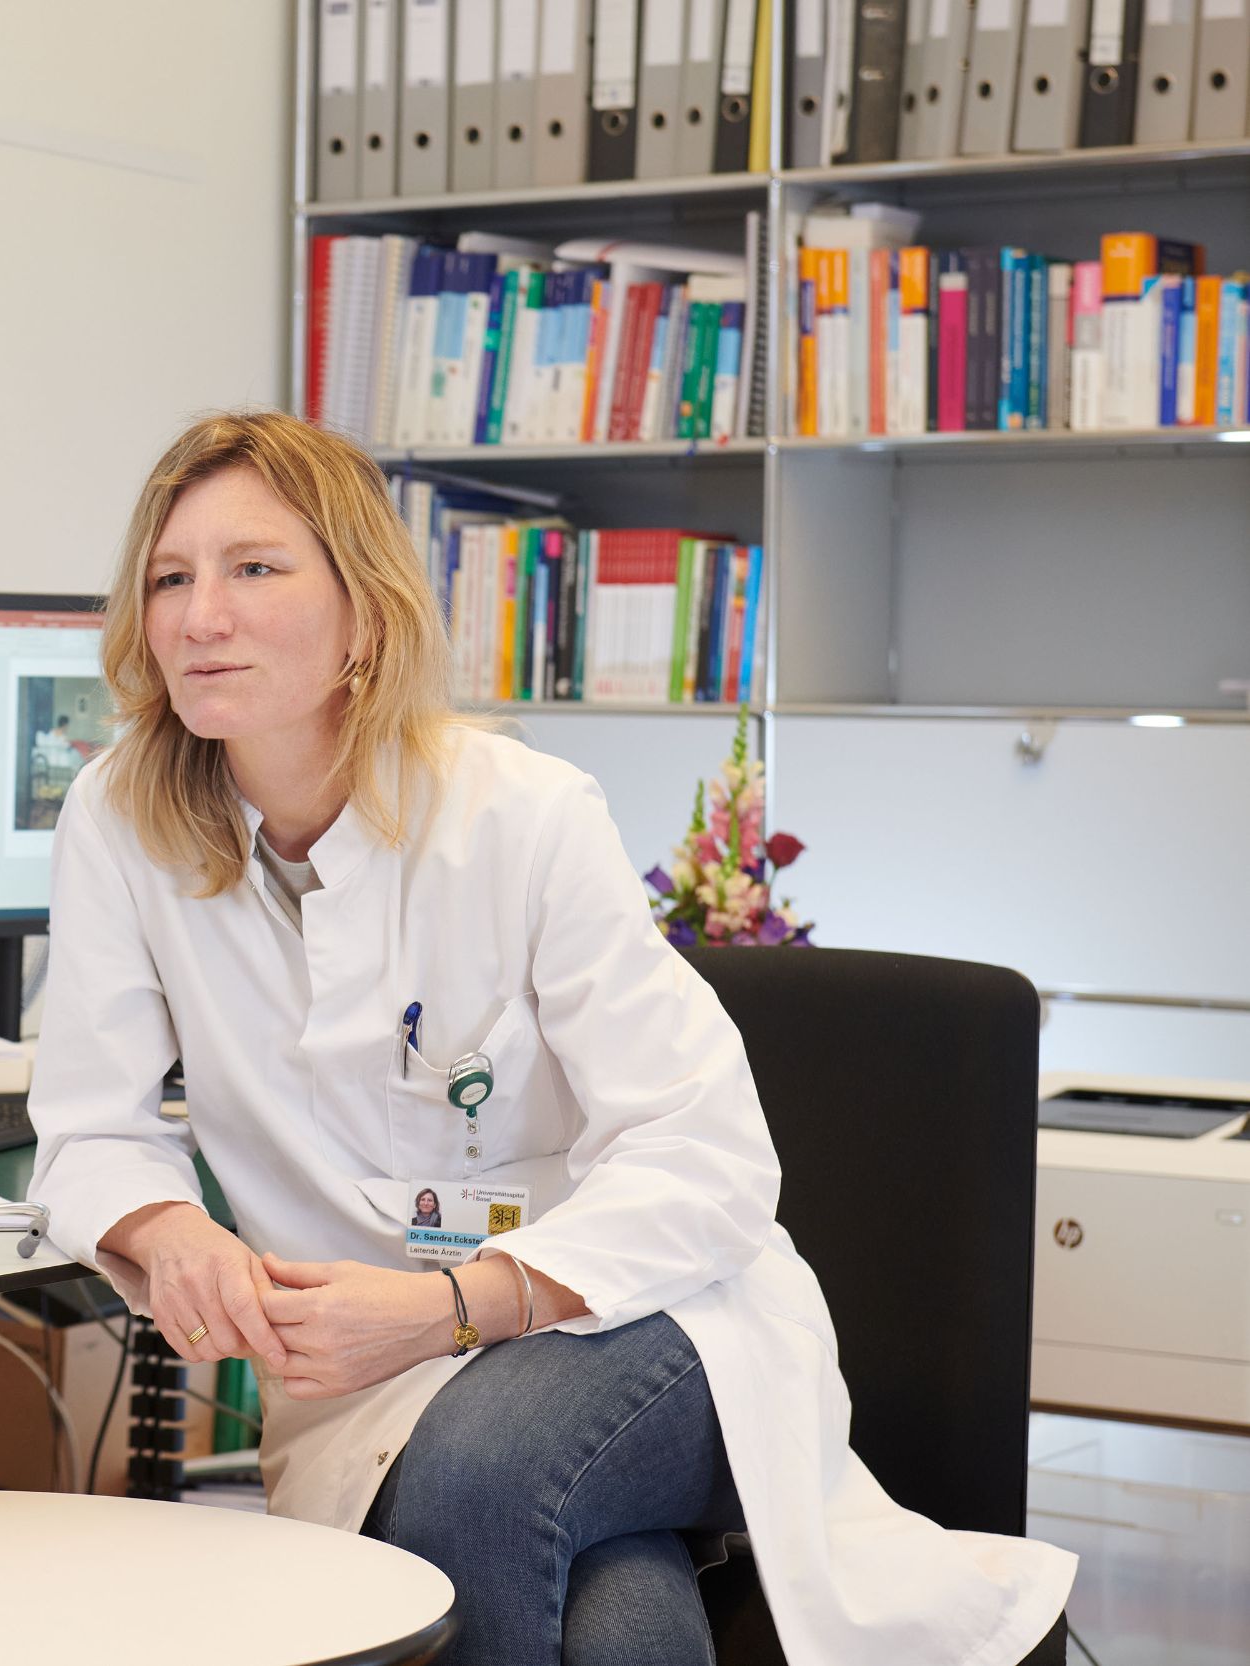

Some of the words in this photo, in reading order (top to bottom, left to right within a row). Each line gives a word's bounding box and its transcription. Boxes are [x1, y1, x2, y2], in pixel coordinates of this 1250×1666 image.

[410, 1231, 422, 1241] Dr.
[423, 1233, 452, 1243] Sandra
[410, 1246, 439, 1255] Leitende
[440, 1247, 462, 1257] Ärztin
